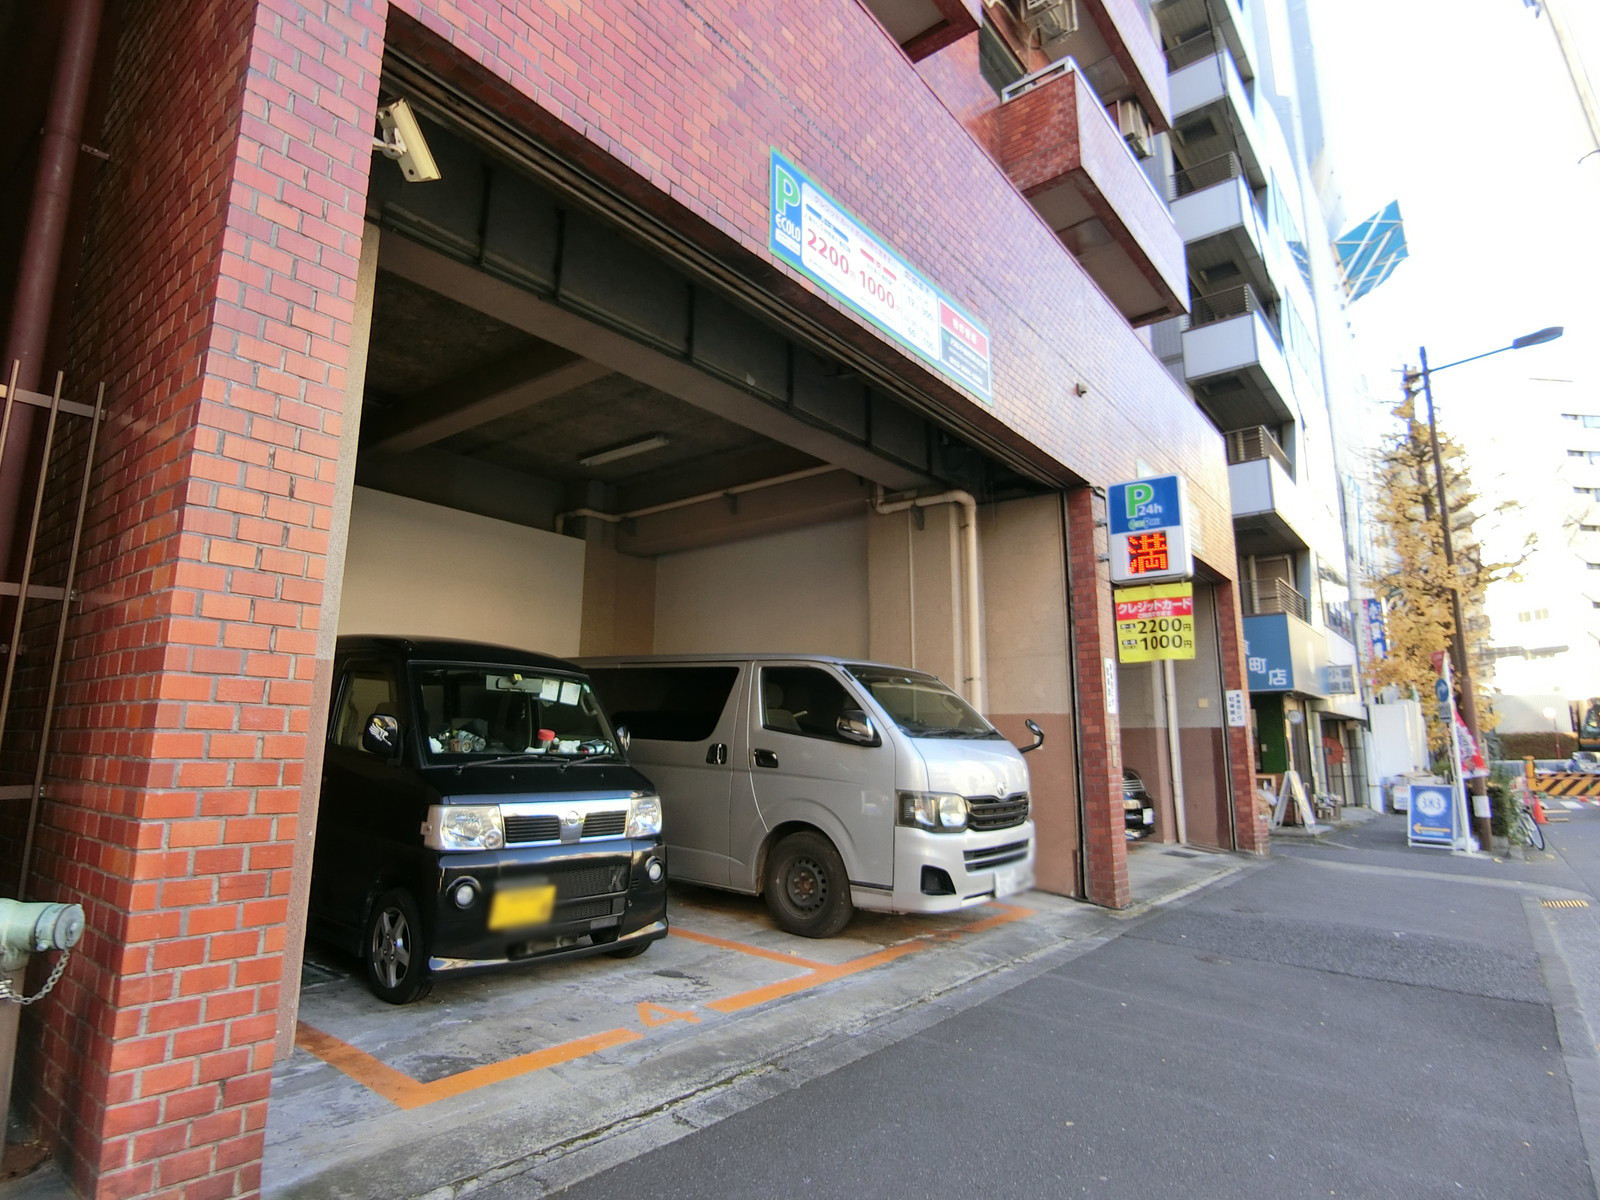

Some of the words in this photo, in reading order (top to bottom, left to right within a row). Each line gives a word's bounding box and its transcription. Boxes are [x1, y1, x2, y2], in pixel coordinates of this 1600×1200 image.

[775, 165, 800, 214] P
[1125, 483, 1154, 519] P
[1138, 503, 1163, 516] 24h
[1127, 533, 1169, 575] 満
[1117, 598, 1192, 615] クレジットカード
